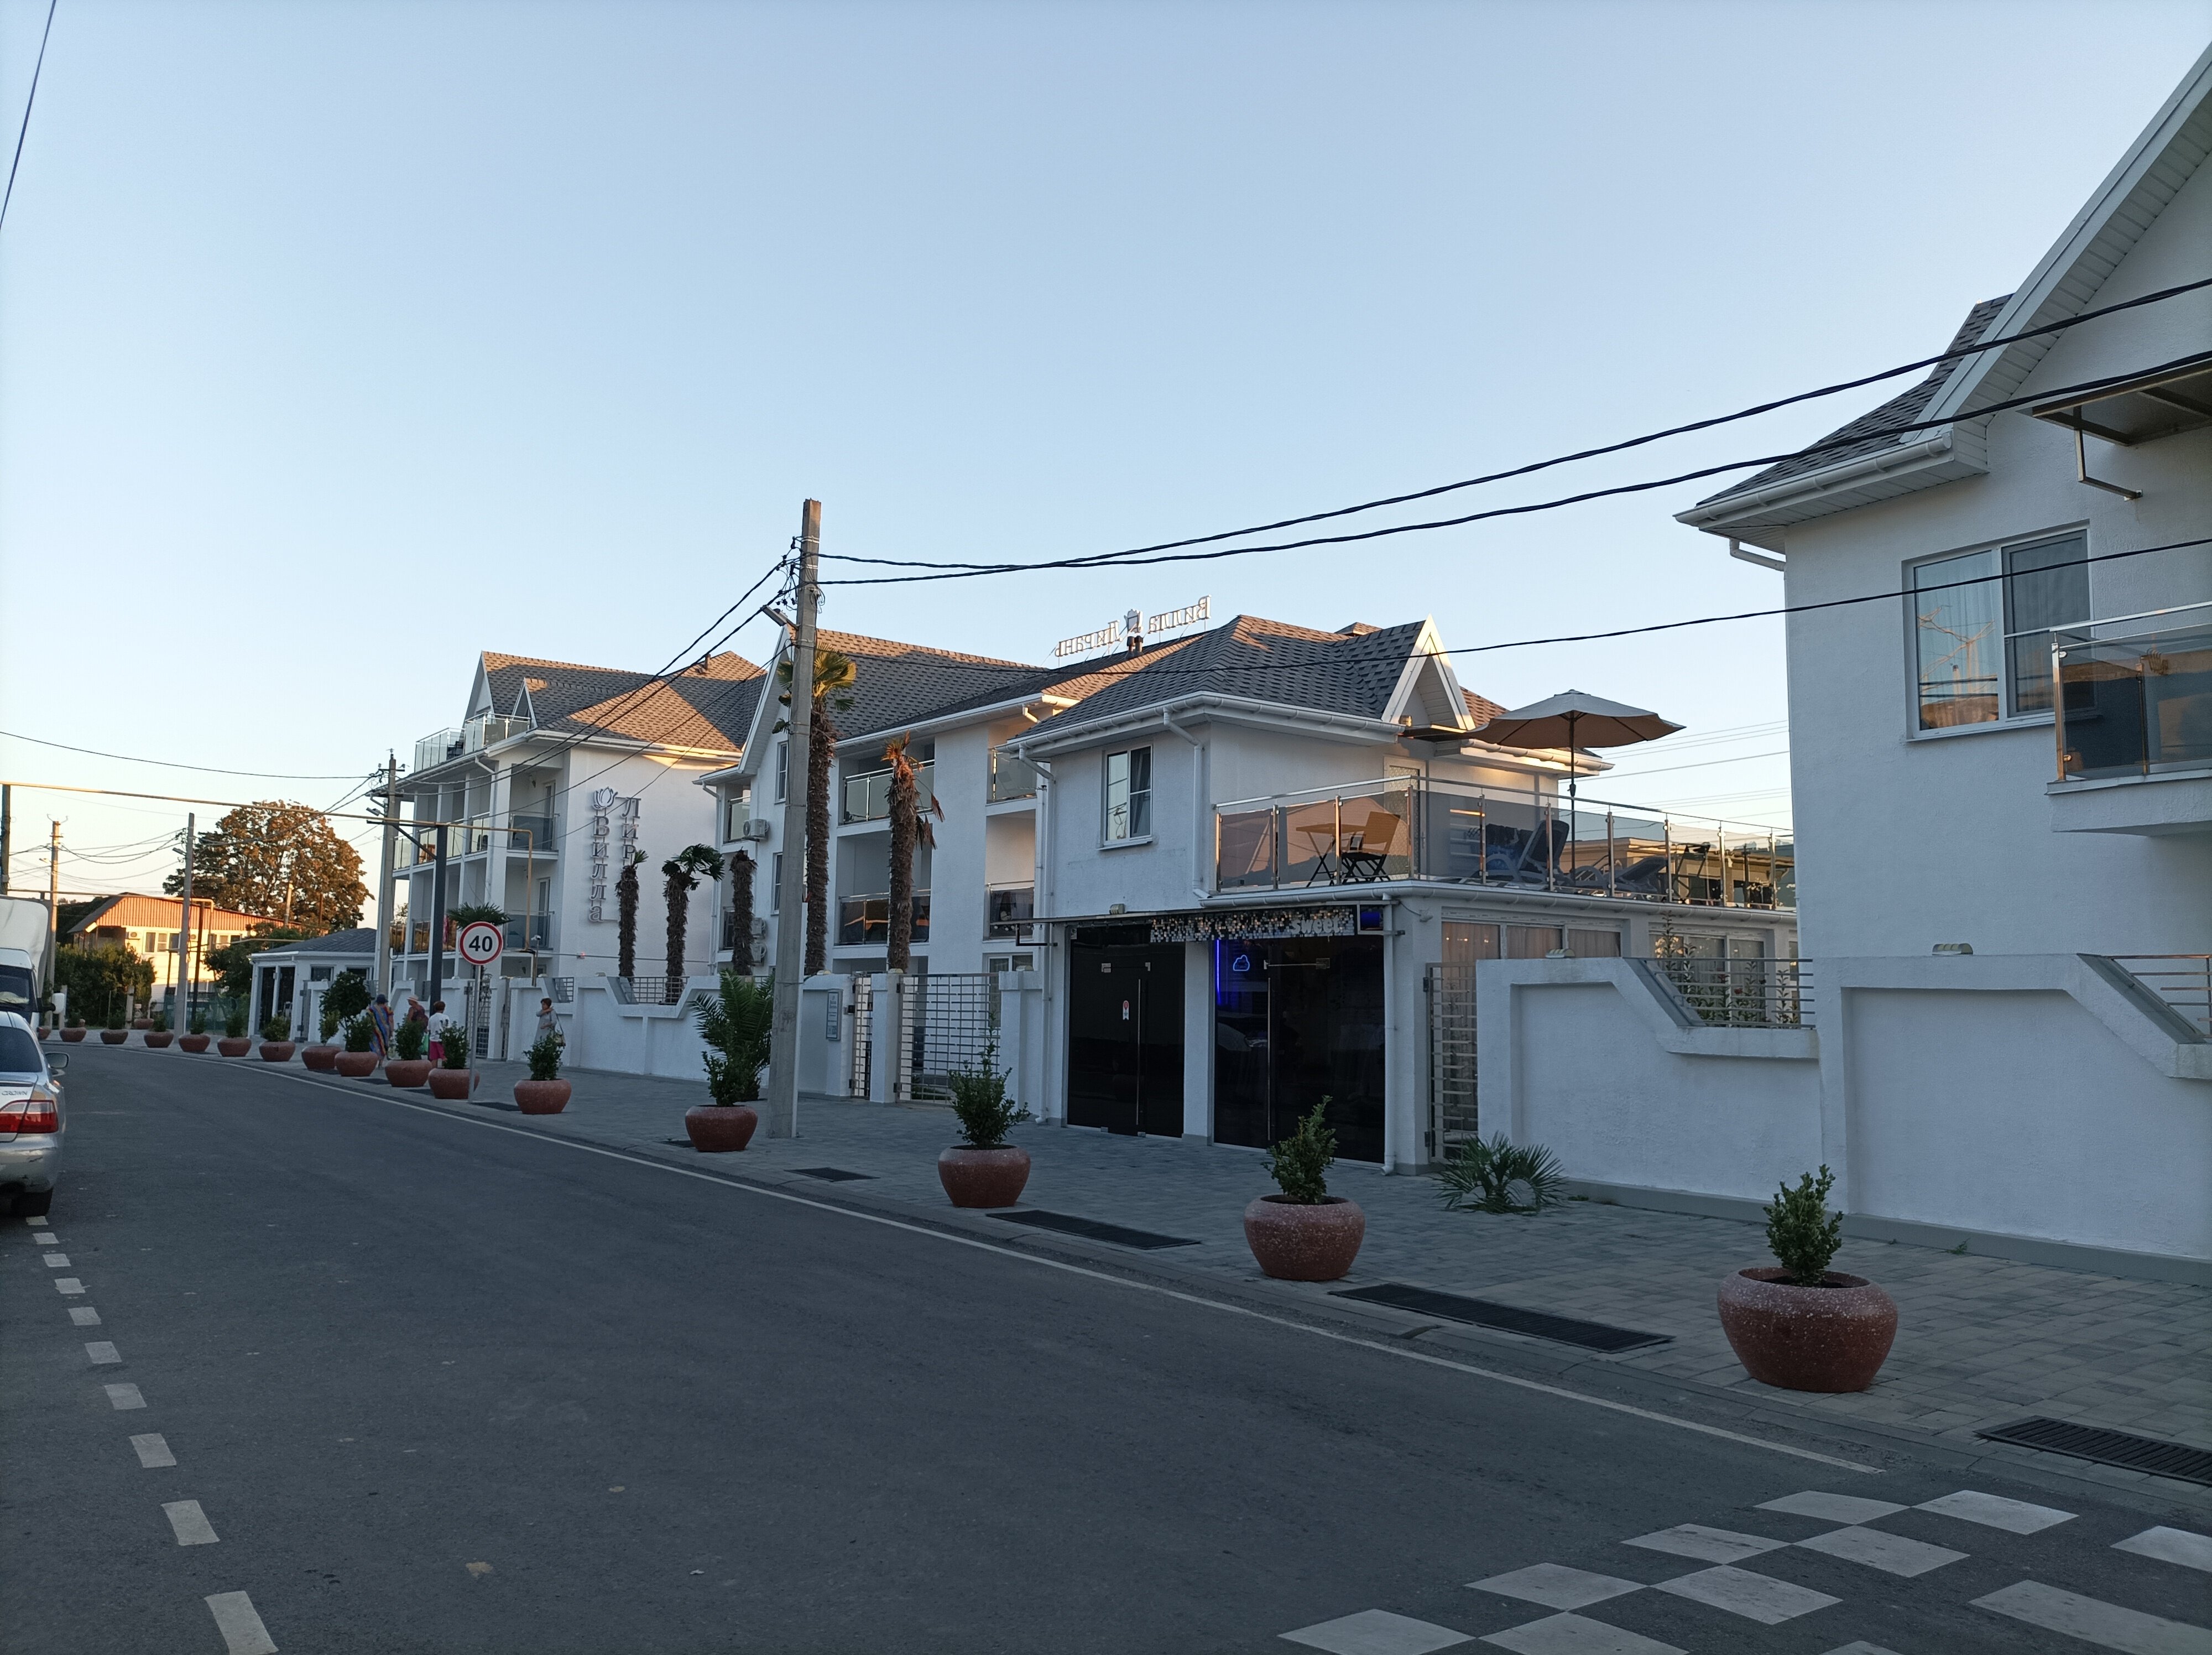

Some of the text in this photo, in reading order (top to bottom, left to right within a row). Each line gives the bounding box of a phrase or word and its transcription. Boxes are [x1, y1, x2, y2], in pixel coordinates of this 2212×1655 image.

[589, 815, 611, 923] Вилла
[1291, 914, 1340, 934] sweet
[468, 935, 493, 952] 40
